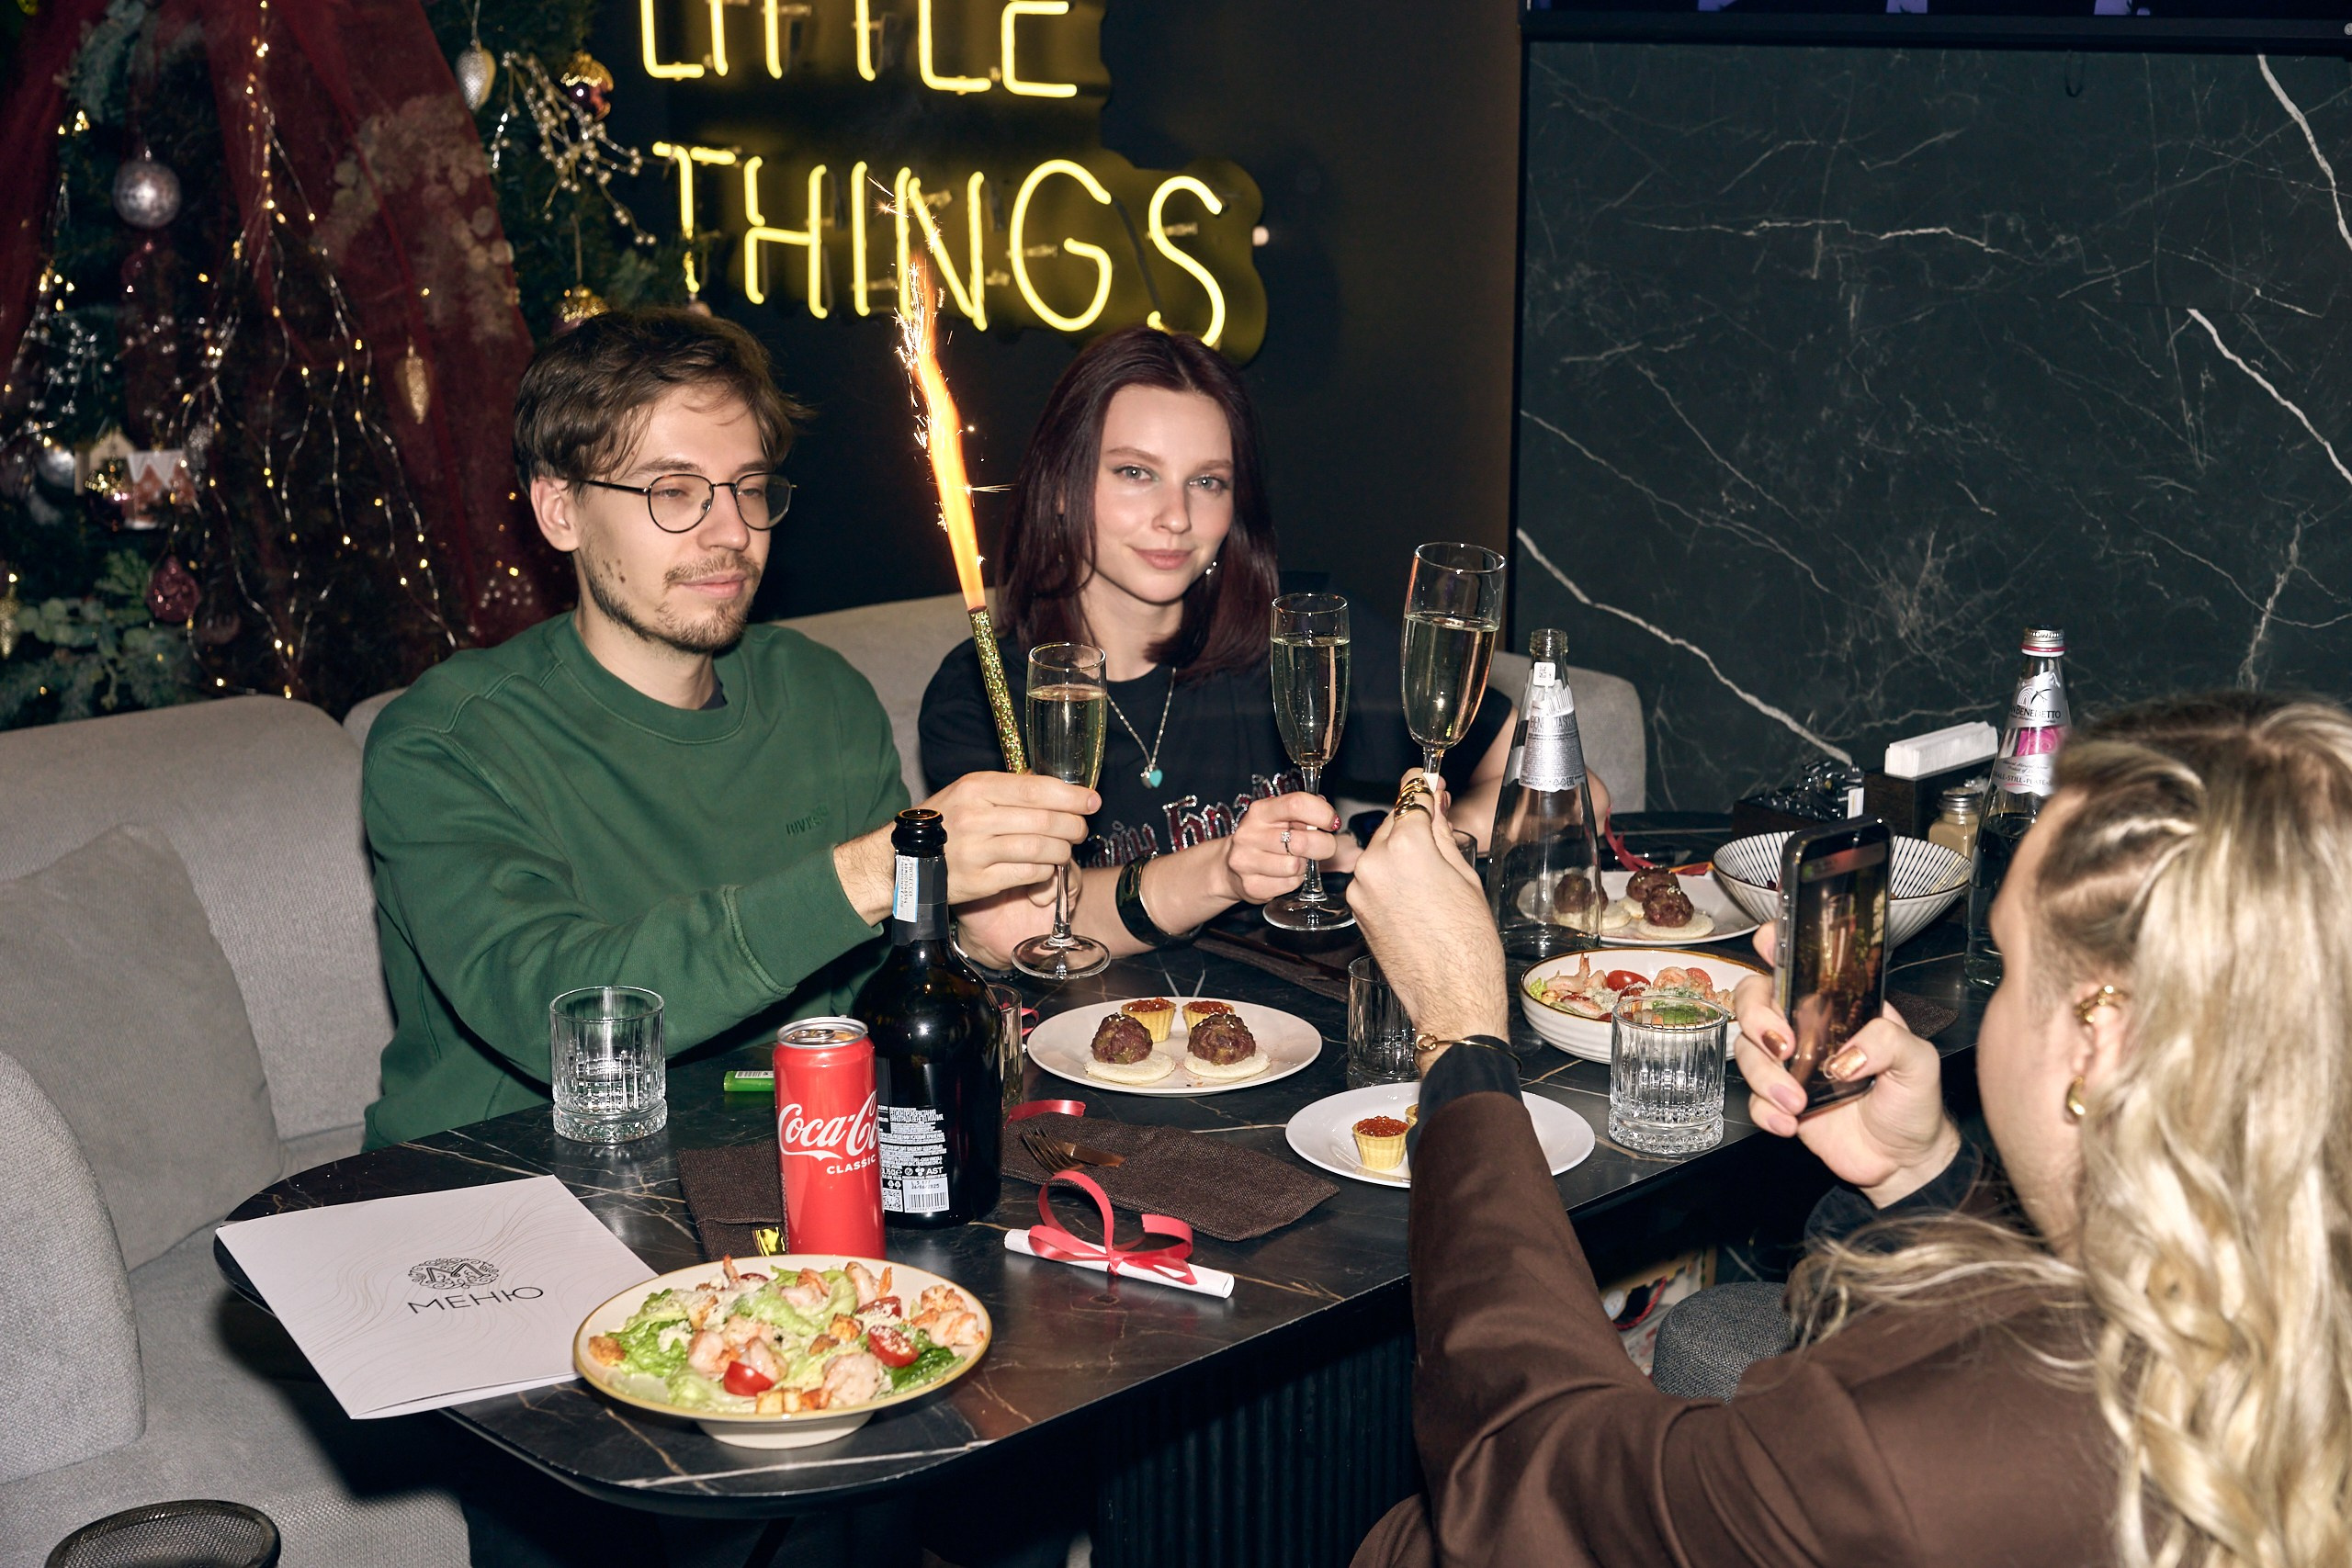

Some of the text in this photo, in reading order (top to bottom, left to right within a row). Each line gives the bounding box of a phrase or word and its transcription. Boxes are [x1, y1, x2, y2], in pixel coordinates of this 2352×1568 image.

[652, 141, 1224, 346] THINGS
[826, 1154, 877, 1175] CLASSIC
[926, 1167, 944, 1176] AST
[407, 1286, 544, 1314] МЕНЮ
